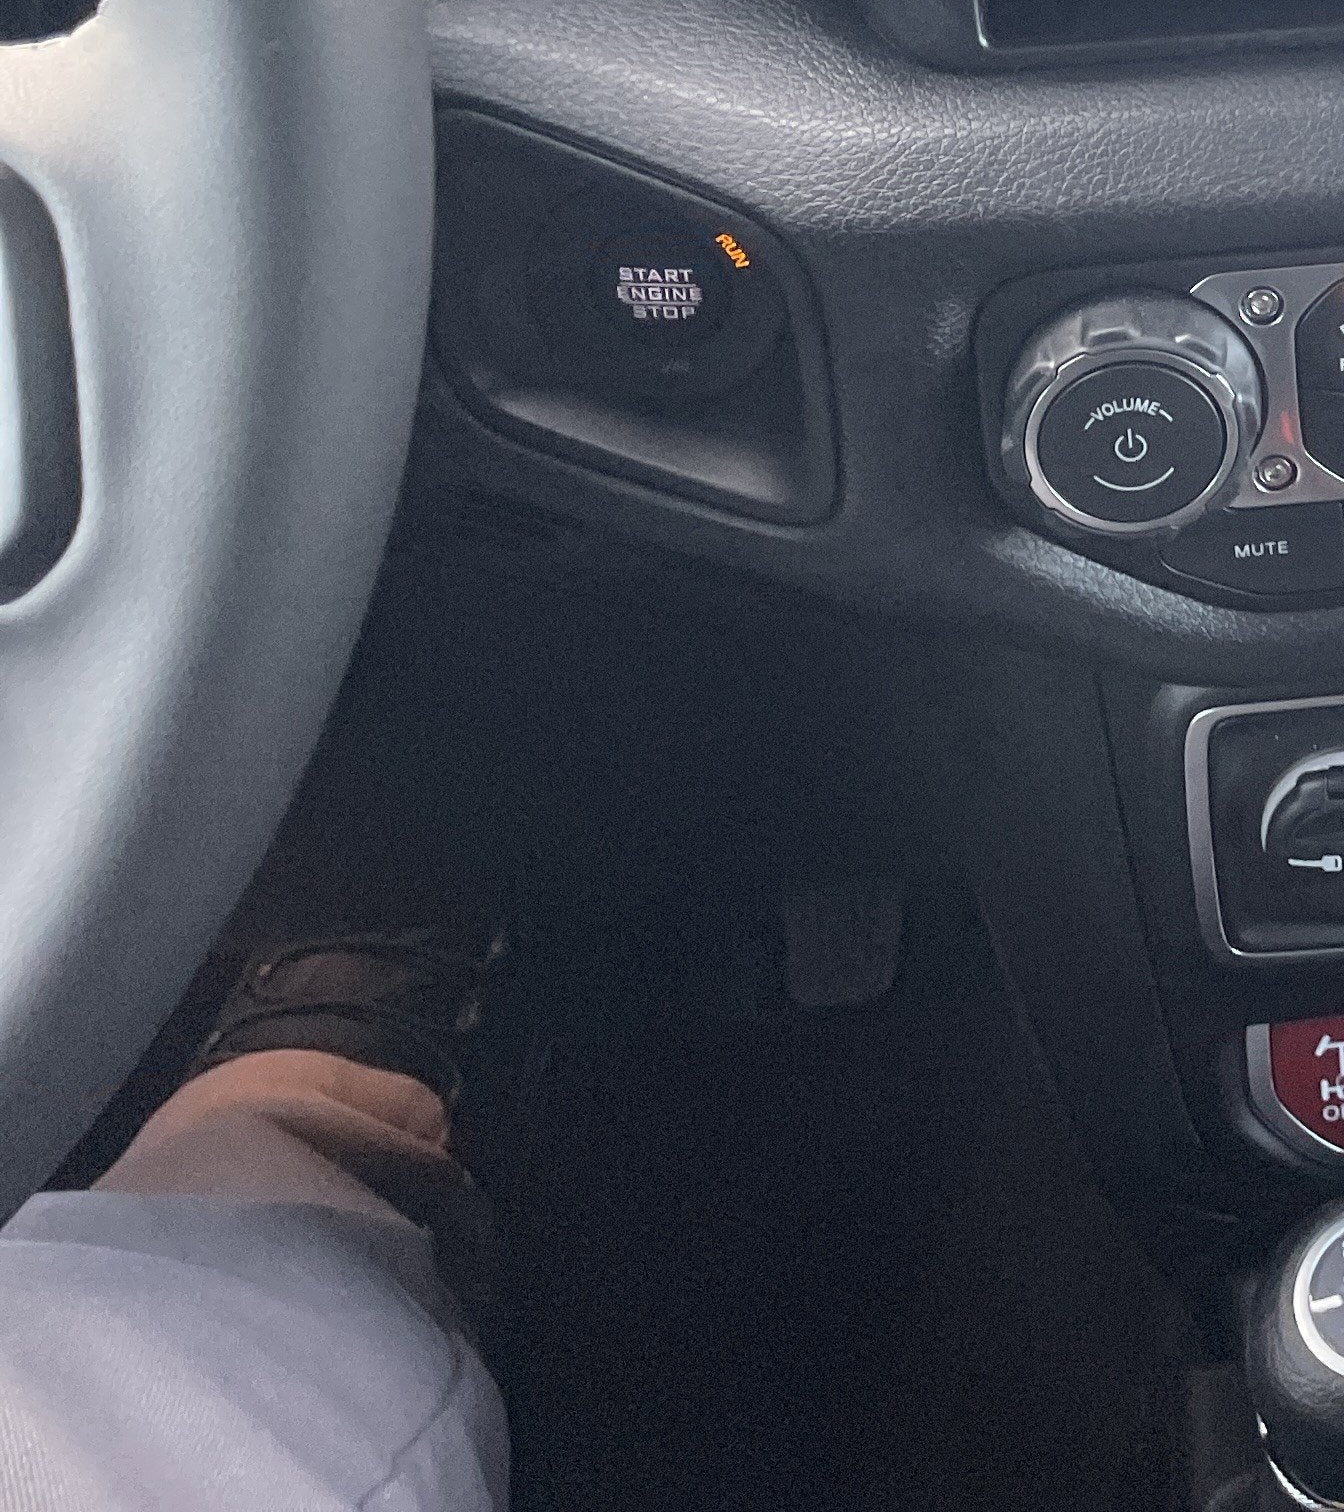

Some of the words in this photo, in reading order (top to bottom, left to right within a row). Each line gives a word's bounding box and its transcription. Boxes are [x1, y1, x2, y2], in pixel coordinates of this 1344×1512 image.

[715, 233, 750, 269] RUN
[618, 266, 693, 283] START
[616, 285, 702, 302] ENGINE
[633, 304, 695, 320] STOP
[1090, 397, 1161, 422] VOLUME
[1234, 540, 1289, 558] MUTE
